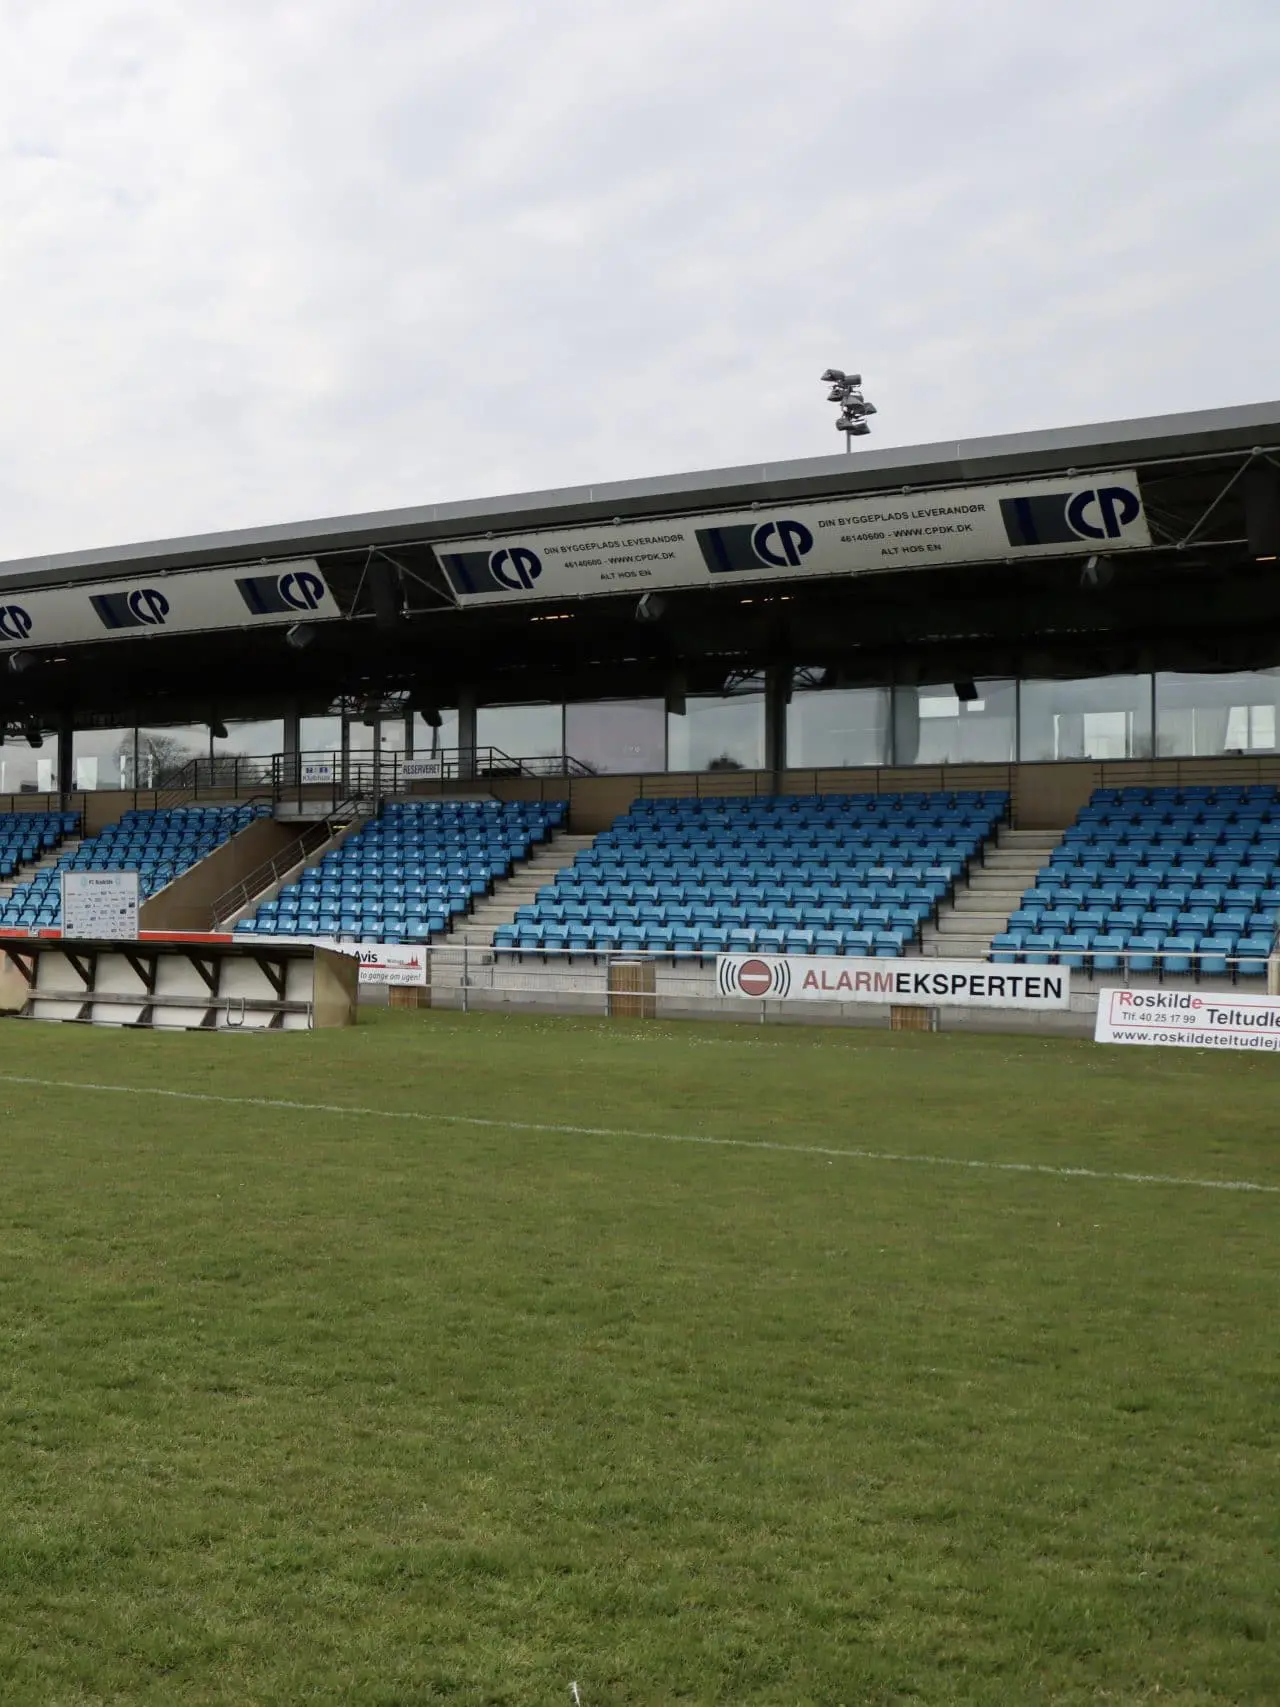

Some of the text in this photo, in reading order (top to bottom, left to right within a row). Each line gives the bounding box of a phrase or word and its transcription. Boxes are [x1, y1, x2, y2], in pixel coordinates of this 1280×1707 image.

[818, 503, 986, 529] DIN BYGGEPLADS LEVERANDØR
[1068, 486, 1140, 539] CP
[893, 524, 973, 539] WWW.CPDK.DK
[544, 533, 685, 556] DIN BYGGEPLADS LEVERANDØR
[754, 520, 814, 567] CP
[881, 546, 901, 557] ALT
[926, 543, 942, 553] EN
[608, 551, 676, 565] WWW.CPDK.DK
[490, 547, 542, 590] CP
[600, 570, 616, 580] ALT
[279, 572, 325, 611] CP
[129, 588, 170, 625] CP
[403, 763, 441, 775] RESERVERET
[354, 950, 378, 963] Avis
[368, 973, 387, 981] gange
[802, 969, 1062, 998] ALARMEKSPERTEN
[1119, 991, 1202, 1009] Roskilde
[1122, 1012, 1196, 1024] Tlf. 40 25 17 99
[1112, 1031, 1280, 1051] www.roskildeteltudlej
